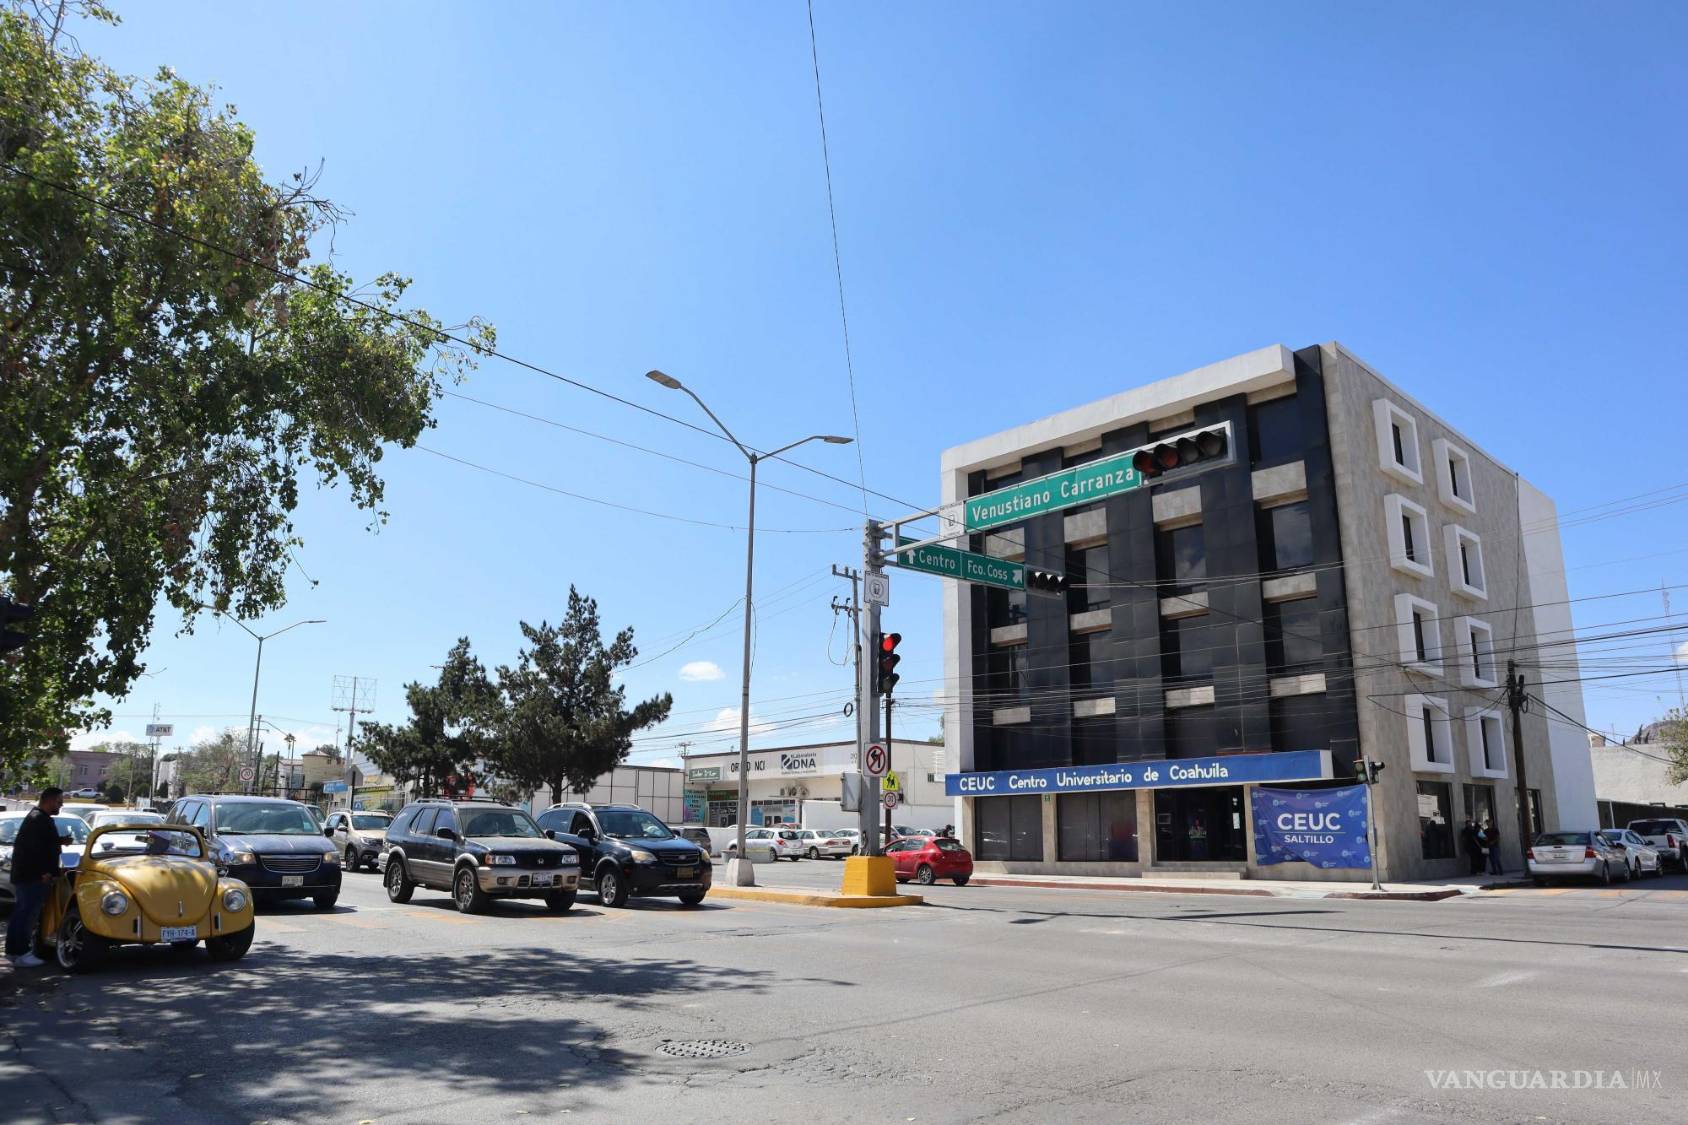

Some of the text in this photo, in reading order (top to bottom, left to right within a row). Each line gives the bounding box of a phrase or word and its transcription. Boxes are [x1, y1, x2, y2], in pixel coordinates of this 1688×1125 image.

[972, 467, 1134, 522] Venustiano Carranza
[919, 550, 955, 570] Centro
[967, 560, 1008, 580] Fco. Coss
[793, 758, 816, 770] DNA
[960, 763, 1229, 791] CEUC Centro Universitario de Coahuila
[1277, 812, 1342, 830] CEUC
[1284, 834, 1335, 844] SALTILLO
